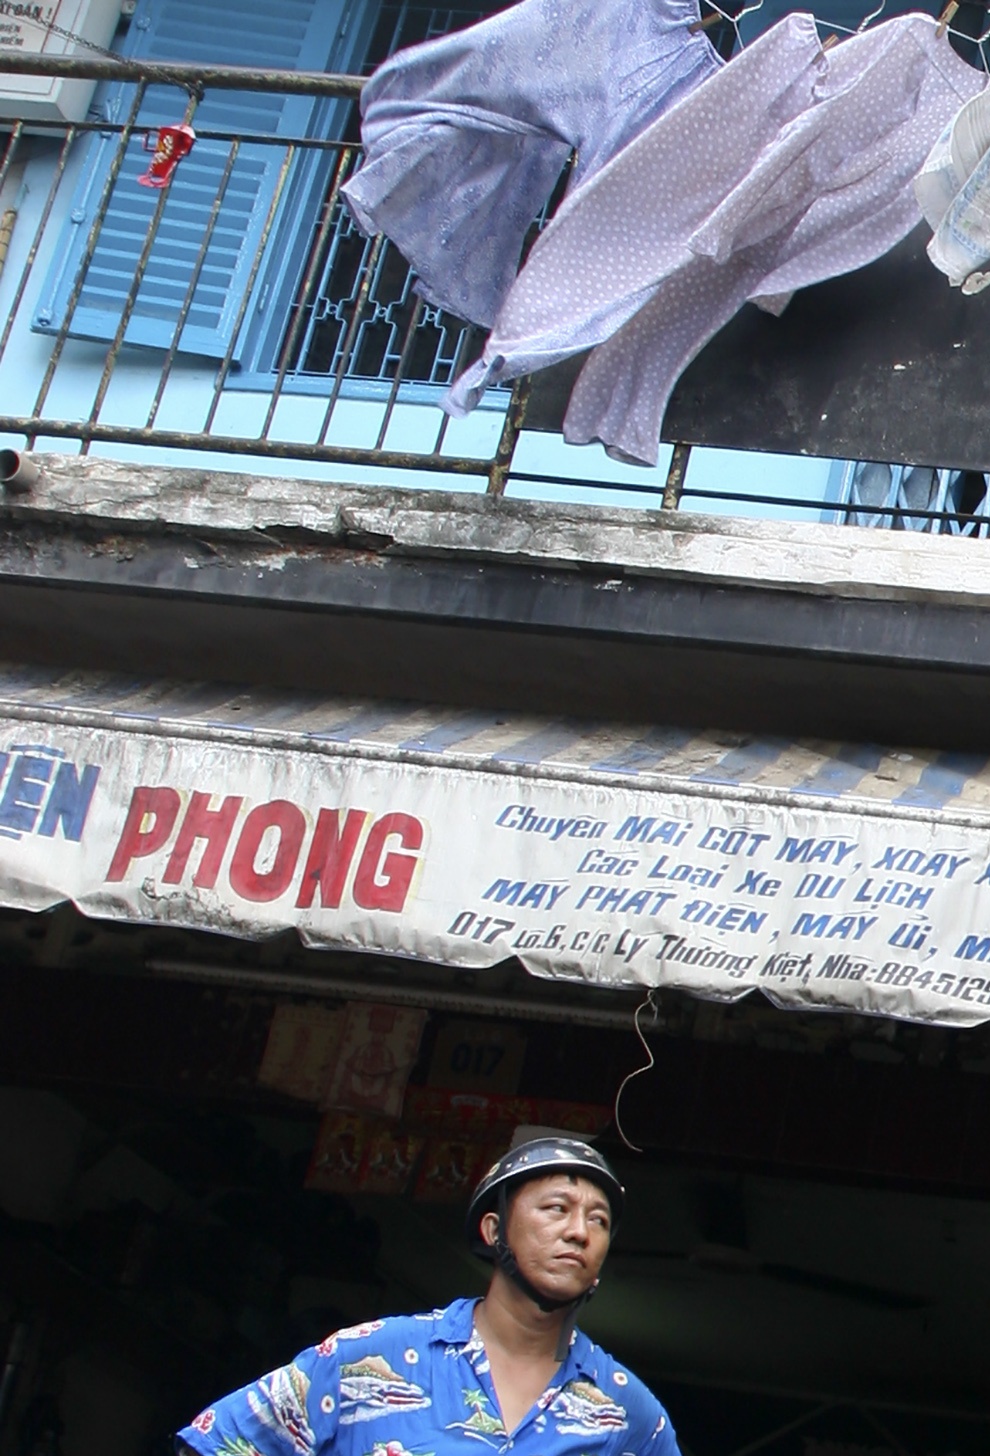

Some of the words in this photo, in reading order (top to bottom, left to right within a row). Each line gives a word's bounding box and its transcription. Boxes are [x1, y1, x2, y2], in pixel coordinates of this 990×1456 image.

[495, 804, 609, 841] Chuyên
[105, 786, 424, 914] PHONG
[647, 855, 729, 891] Loại
[734, 869, 782, 897] Xe
[793, 873, 847, 899] DU
[447, 911, 516, 945] 017
[450, 1042, 506, 1078] 017
